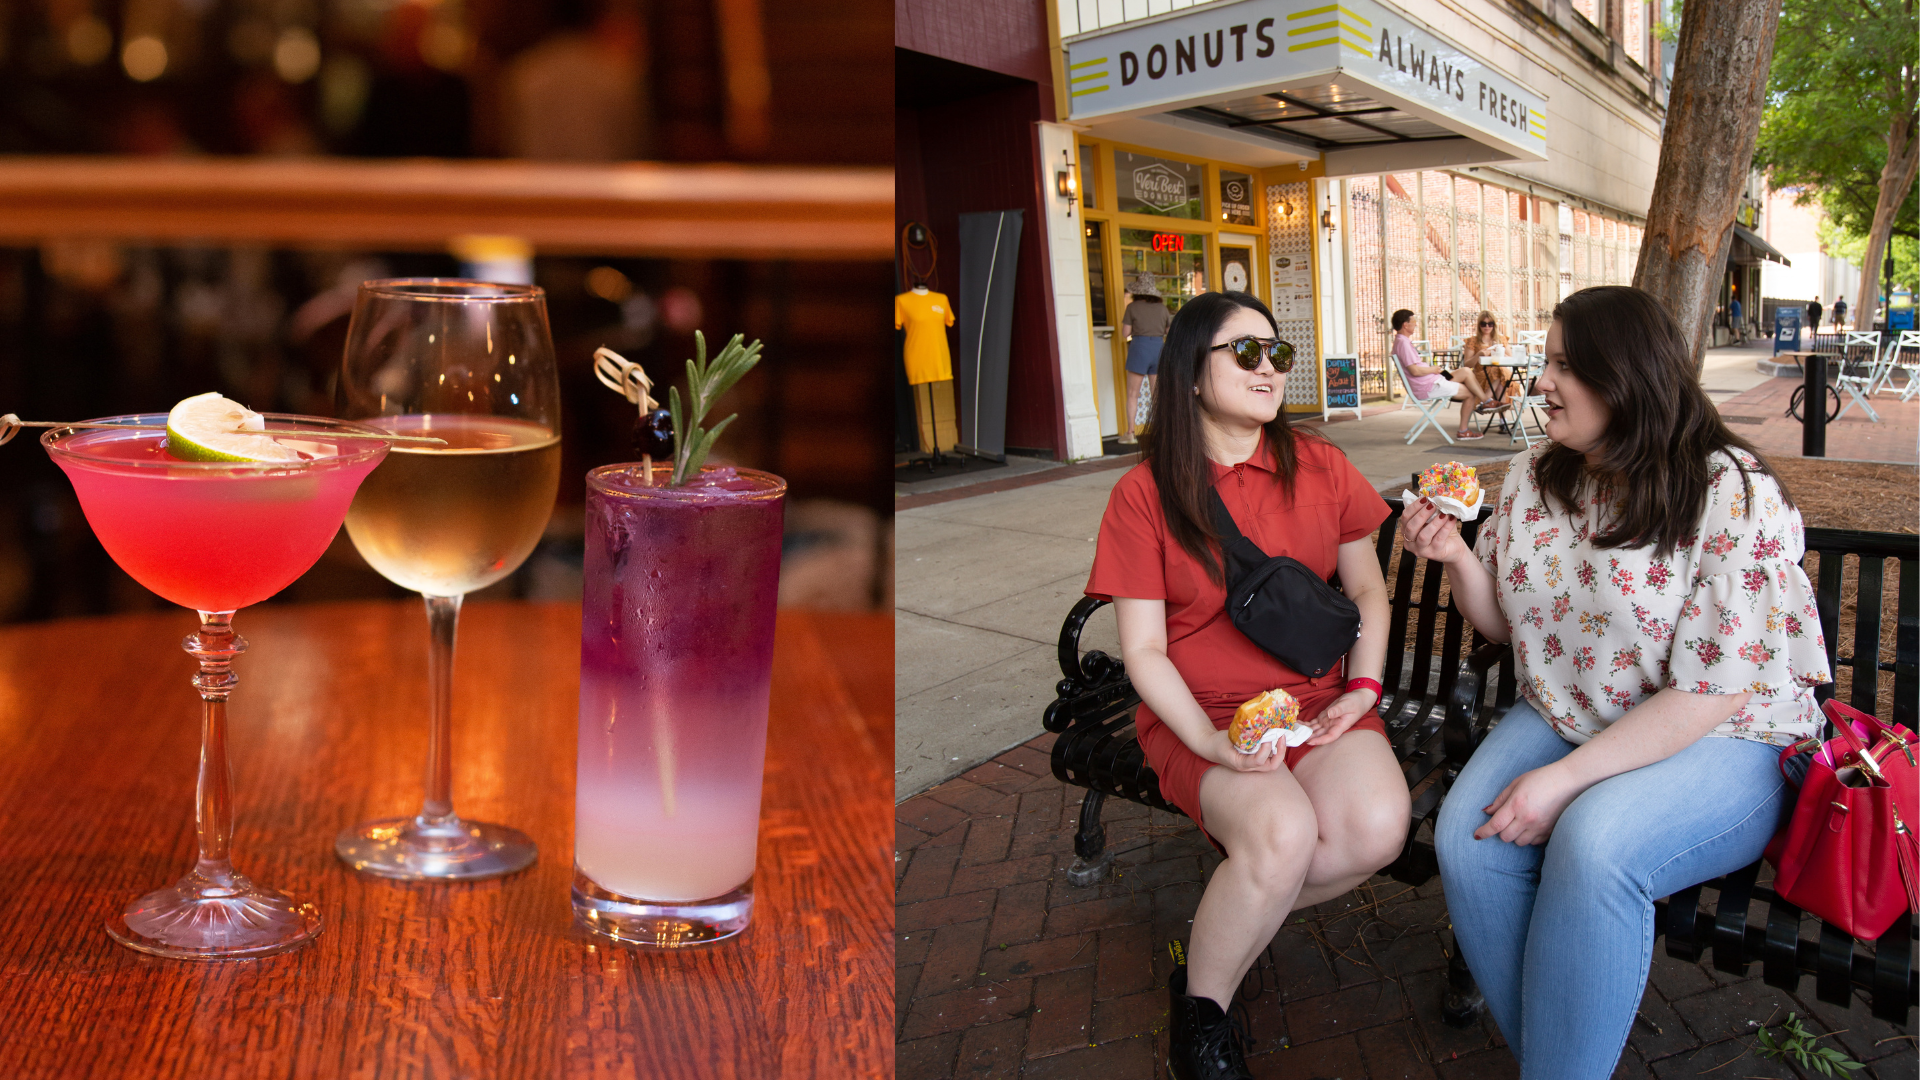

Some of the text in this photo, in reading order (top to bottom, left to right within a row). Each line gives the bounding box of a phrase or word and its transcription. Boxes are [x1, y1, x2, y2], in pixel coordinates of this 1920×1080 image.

[1119, 17, 1275, 86] DONUTS
[1378, 27, 1527, 132] ALWAYS FRESH
[1136, 172, 1184, 195] Veri Best
[1143, 190, 1179, 202] DONUTS
[1152, 233, 1184, 252] OPEN
